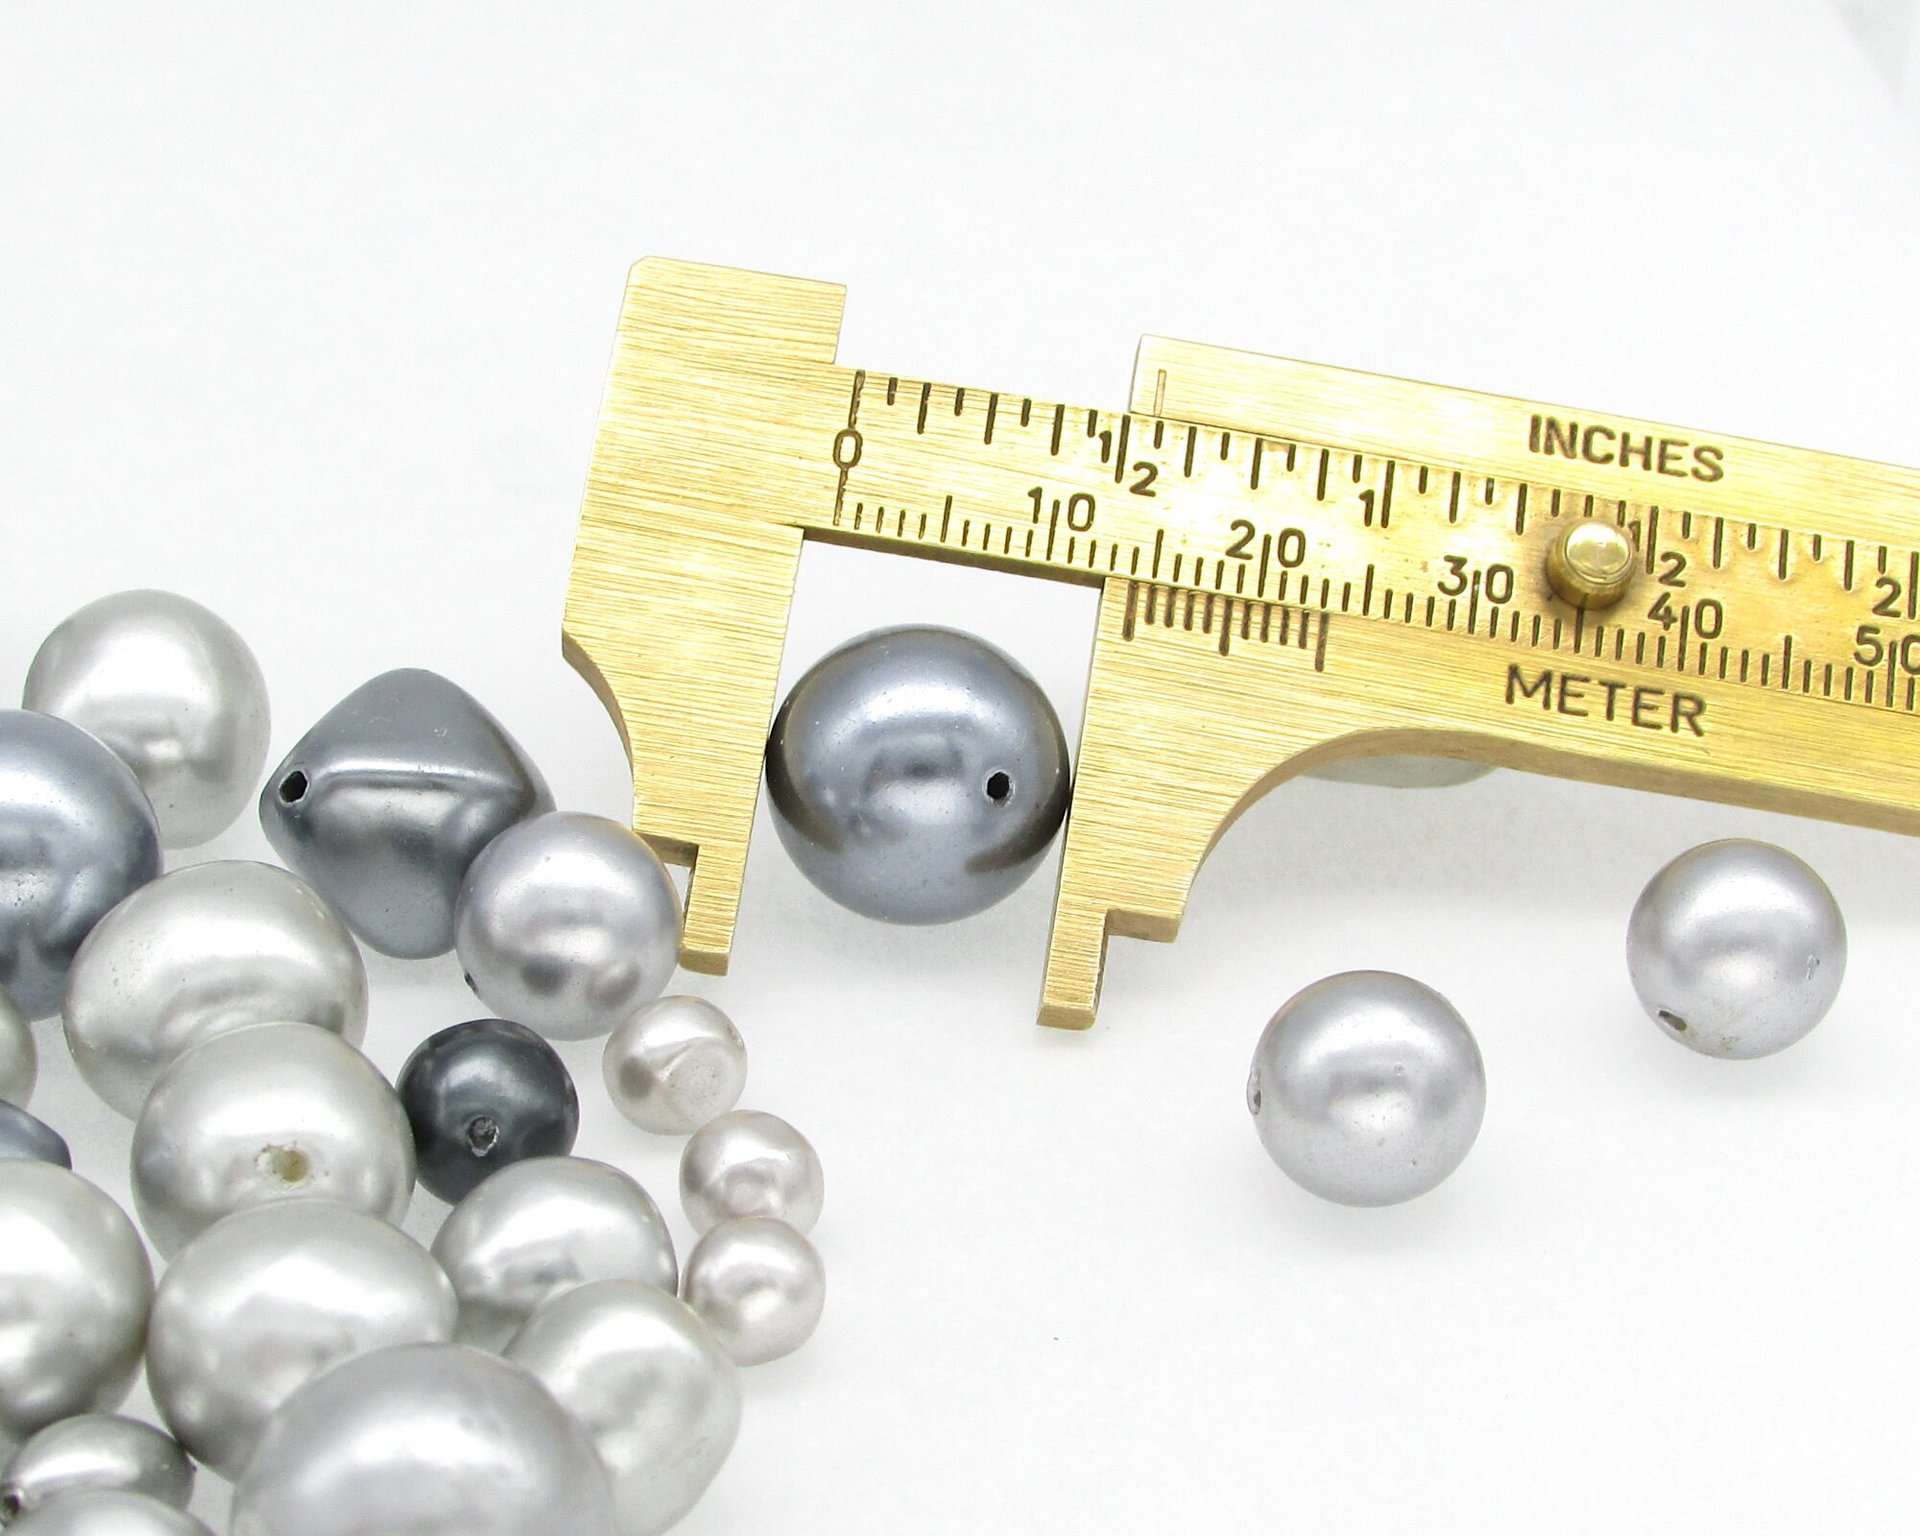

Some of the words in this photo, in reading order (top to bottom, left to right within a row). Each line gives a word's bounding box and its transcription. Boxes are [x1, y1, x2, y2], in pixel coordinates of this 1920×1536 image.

[832, 428, 864, 470] 0
[1529, 414, 1724, 482] INCHES
[1506, 663, 1706, 736] METER
